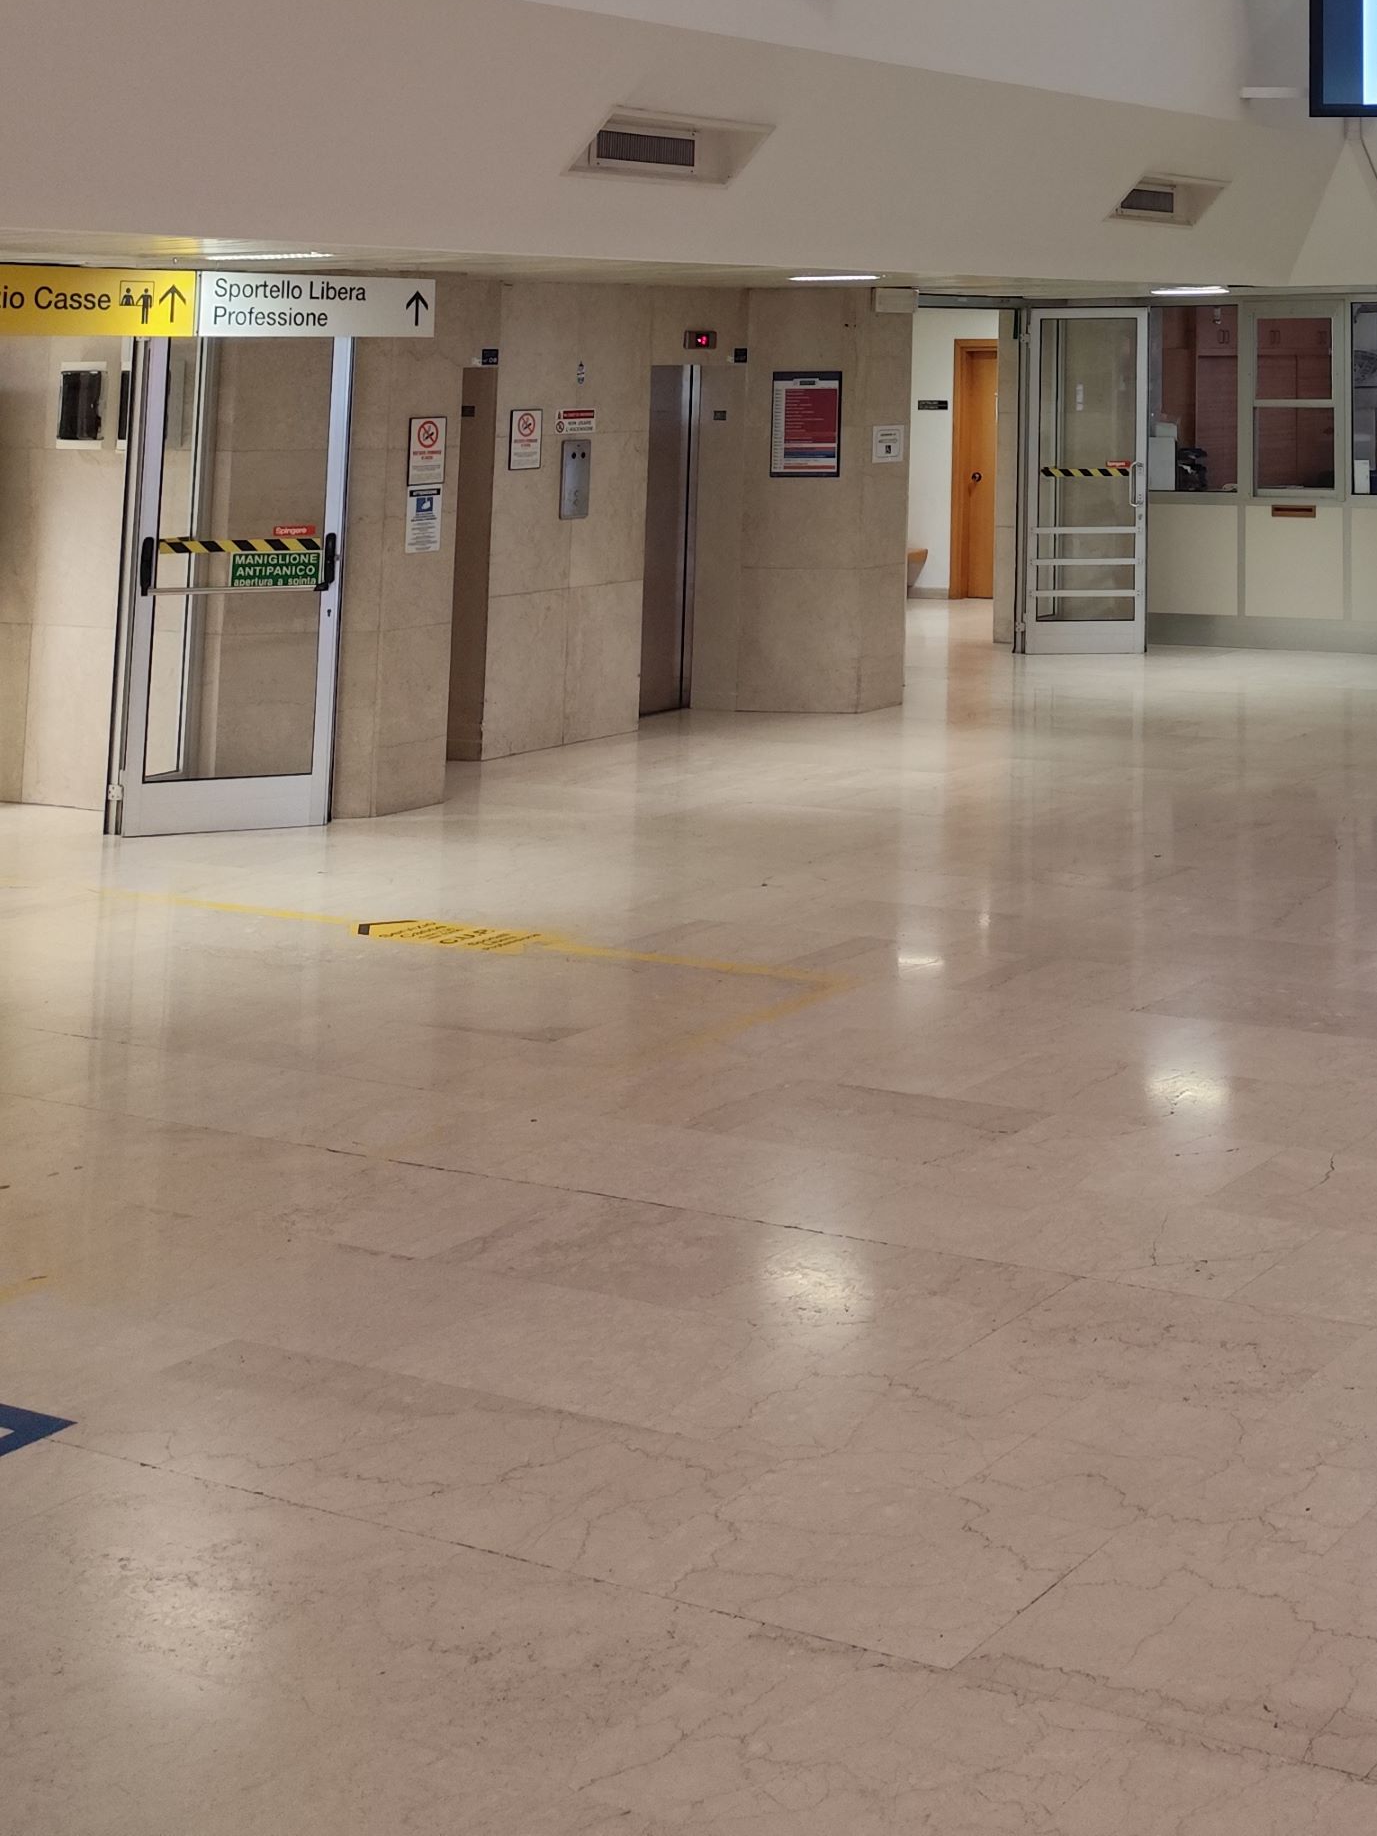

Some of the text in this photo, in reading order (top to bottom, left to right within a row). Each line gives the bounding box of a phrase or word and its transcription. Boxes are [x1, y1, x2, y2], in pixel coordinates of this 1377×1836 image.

[0, 286, 111, 311] io Casse
[214, 277, 366, 302] Sportello Libera
[213, 306, 328, 327] Professione
[235, 553, 318, 565] MANIGLIONE
[236, 565, 316, 577] ANTIPANICO
